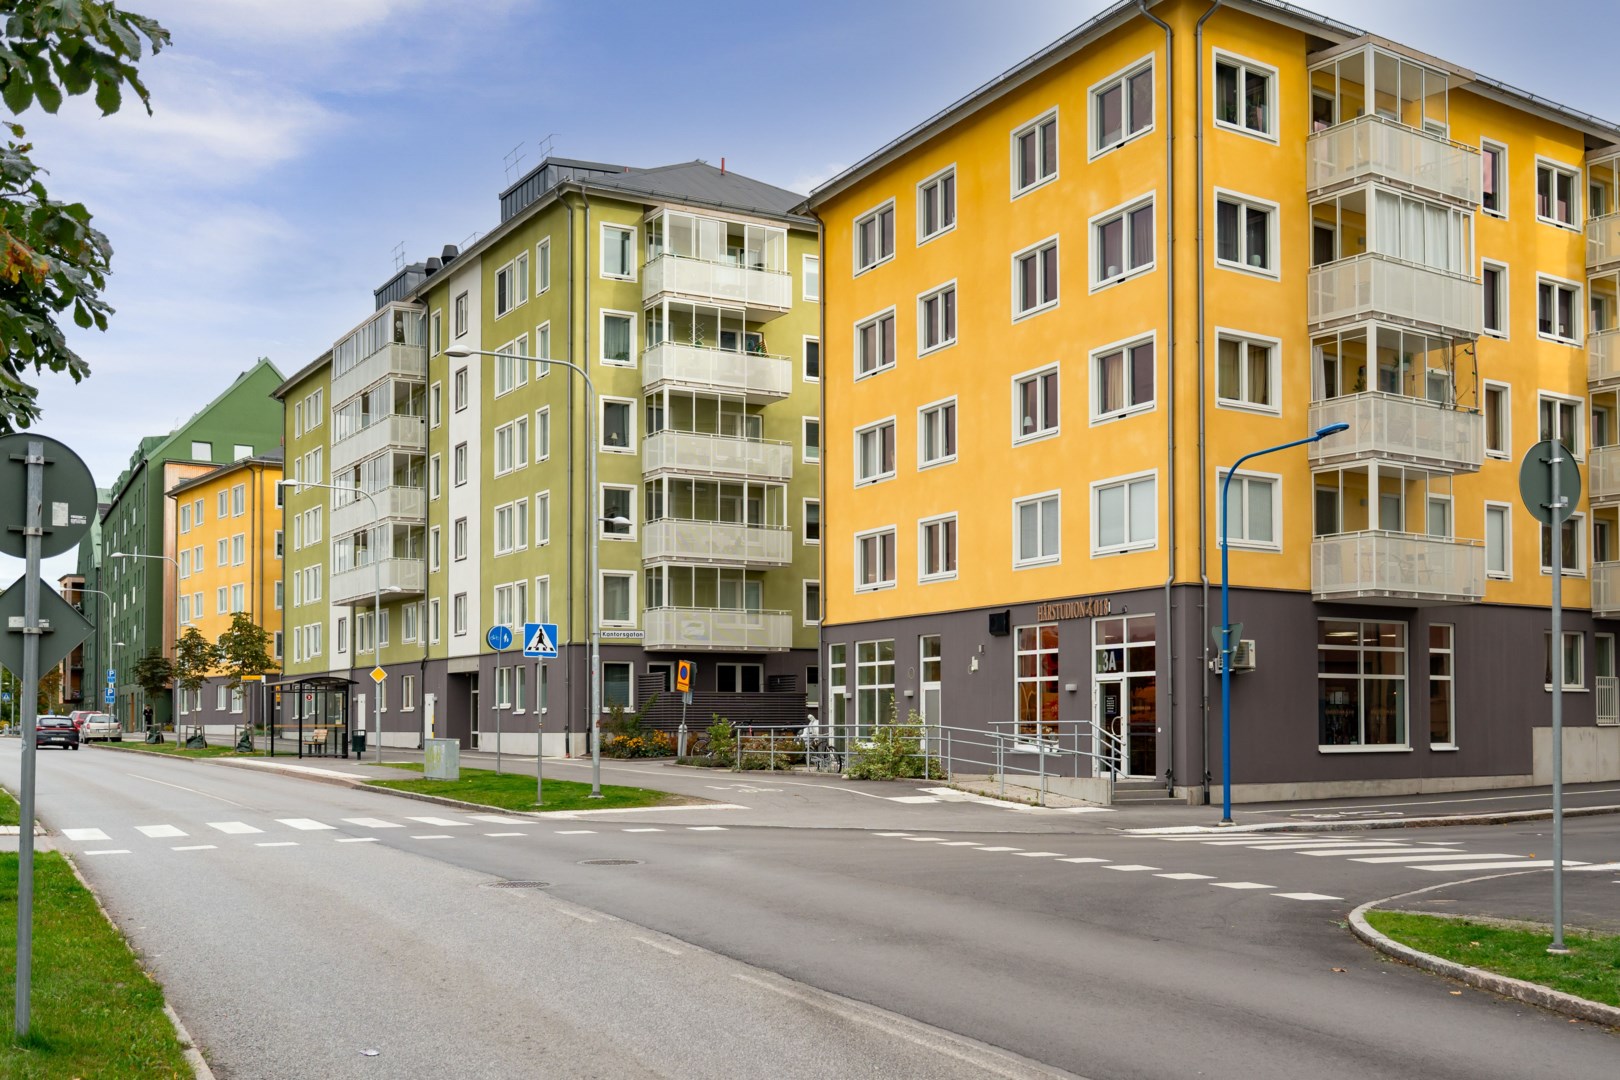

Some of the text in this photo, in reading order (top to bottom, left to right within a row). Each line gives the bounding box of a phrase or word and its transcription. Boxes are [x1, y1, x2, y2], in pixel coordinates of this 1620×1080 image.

[1037, 598, 1109, 621] HÅRSTUDION 018
[1102, 651, 1117, 671] 3A
